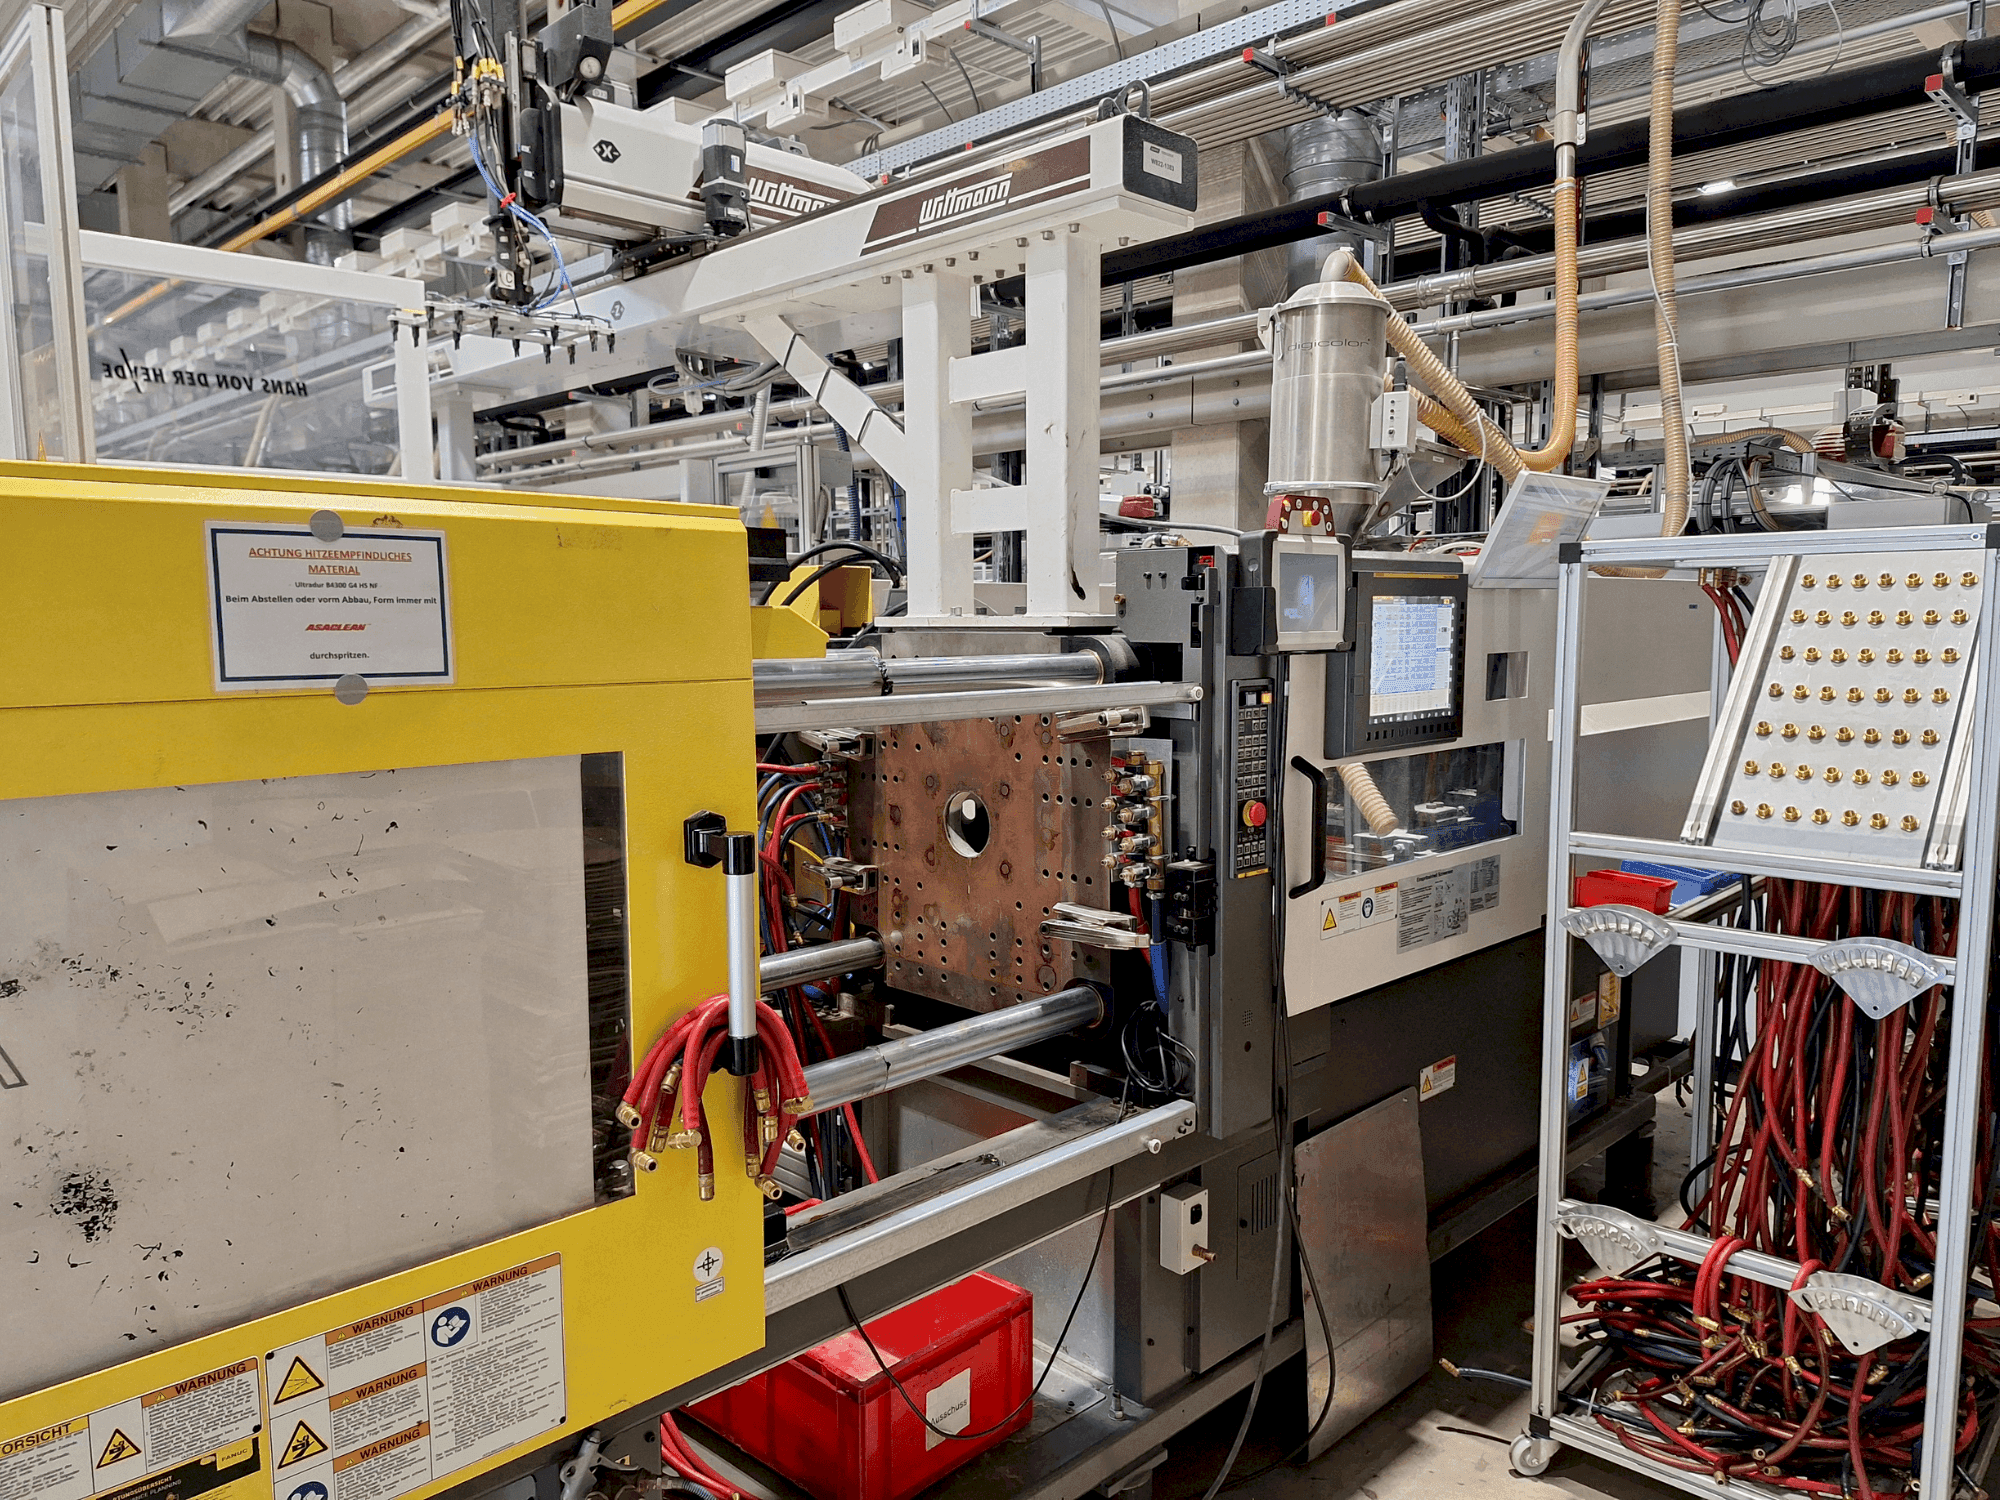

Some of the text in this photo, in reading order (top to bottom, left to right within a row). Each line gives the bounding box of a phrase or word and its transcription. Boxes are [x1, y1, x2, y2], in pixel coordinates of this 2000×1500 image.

[248, 547, 412, 561] ACHTUNG HITZEEMPFINDLICHES
[308, 564, 361, 575] MATERIAL
[225, 595, 249, 603] Beim
[251, 595, 294, 603] Abstellen
[295, 595, 316, 603] oder
[342, 596, 372, 605] Abbau,
[373, 596, 395, 604] Form
[424, 597, 438, 605] mit
[309, 651, 370, 660] durchspritzen.
[472, 1266, 528, 1292] WARNUNG
[351, 1306, 414, 1335] WARNUNG
[174, 1362, 247, 1395] WARNUNG
[355, 1369, 418, 1399] WARNUNG
[1, 1422, 72, 1455] ORSICHT
[359, 1429, 421, 1460] WARNUNG
[221, 1448, 248, 1462] FANUC
